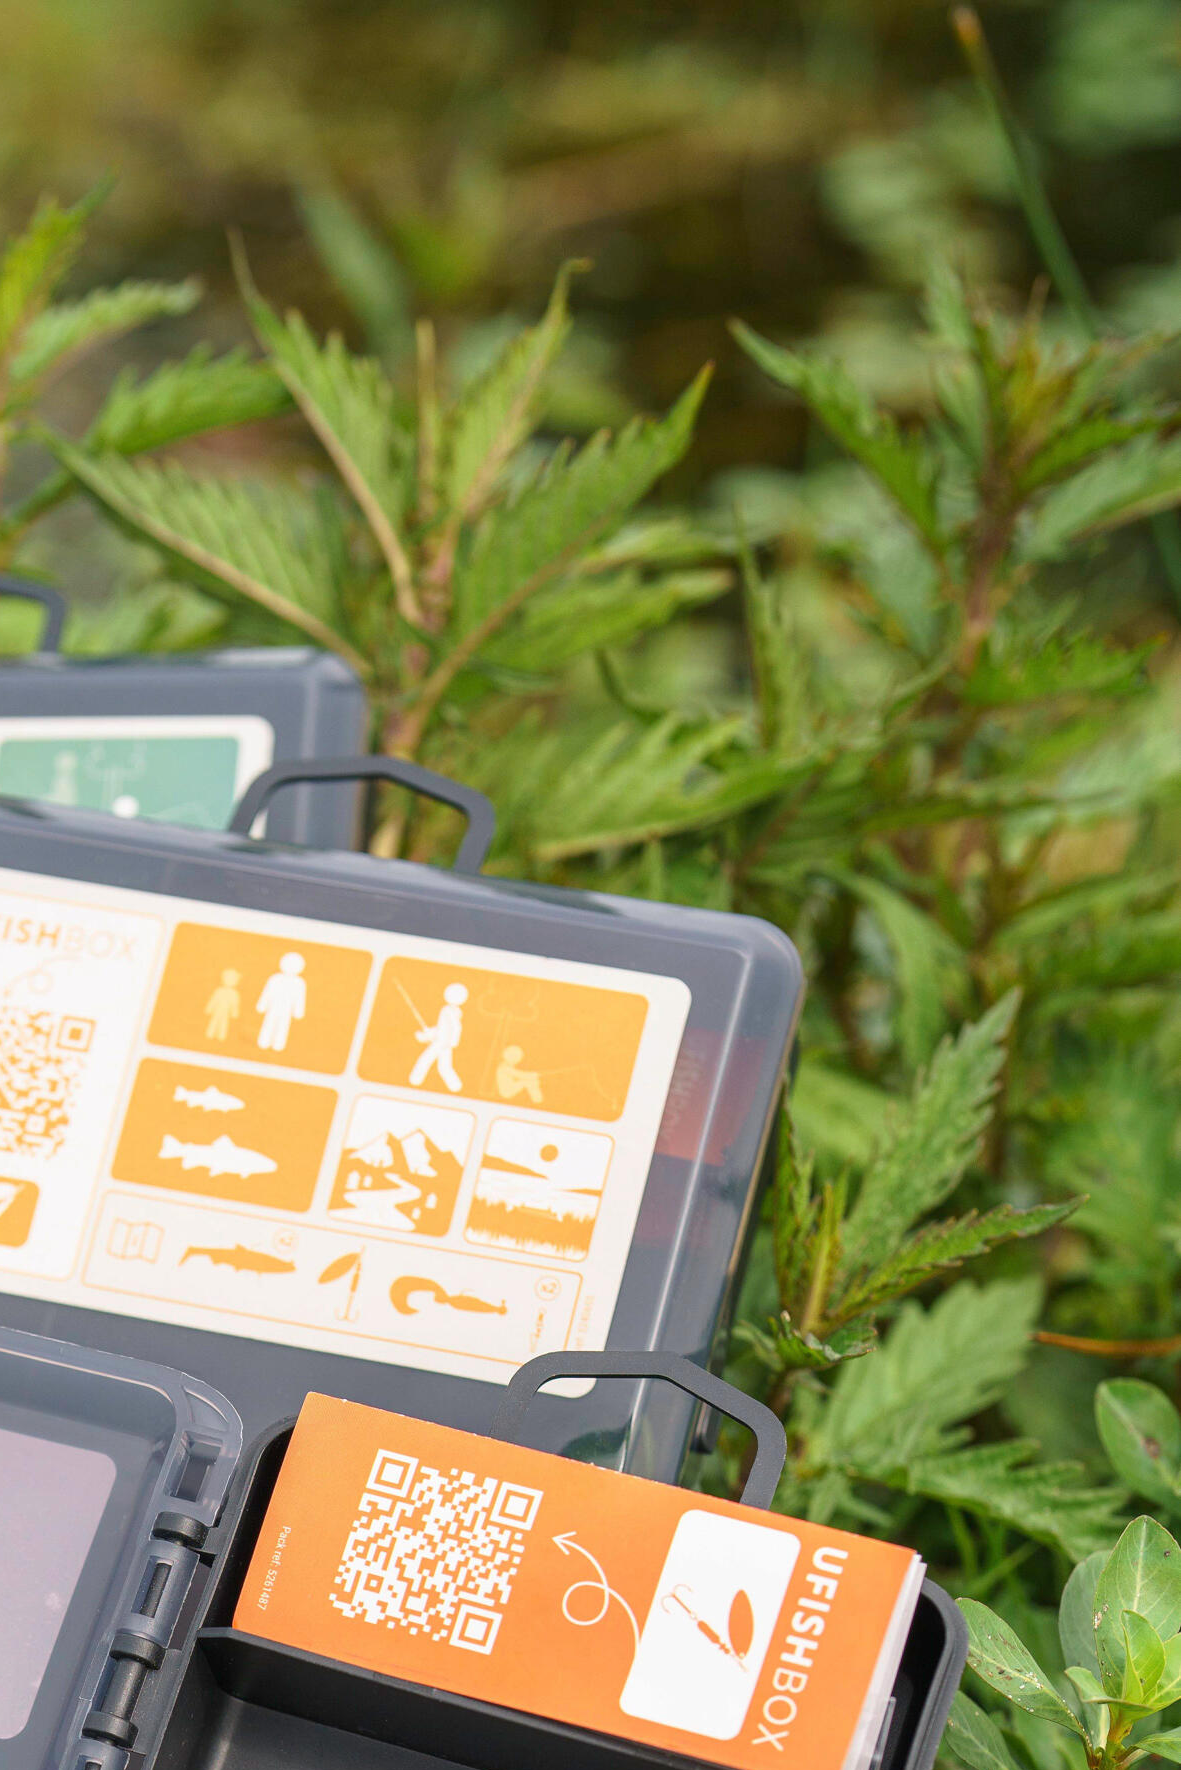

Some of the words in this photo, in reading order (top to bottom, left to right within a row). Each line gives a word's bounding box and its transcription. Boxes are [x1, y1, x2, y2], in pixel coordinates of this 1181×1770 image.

[275, 1525, 292, 1549] Pack
[256, 1568, 278, 1611] 5261487
[751, 1546, 849, 1752] UFISHBOX
